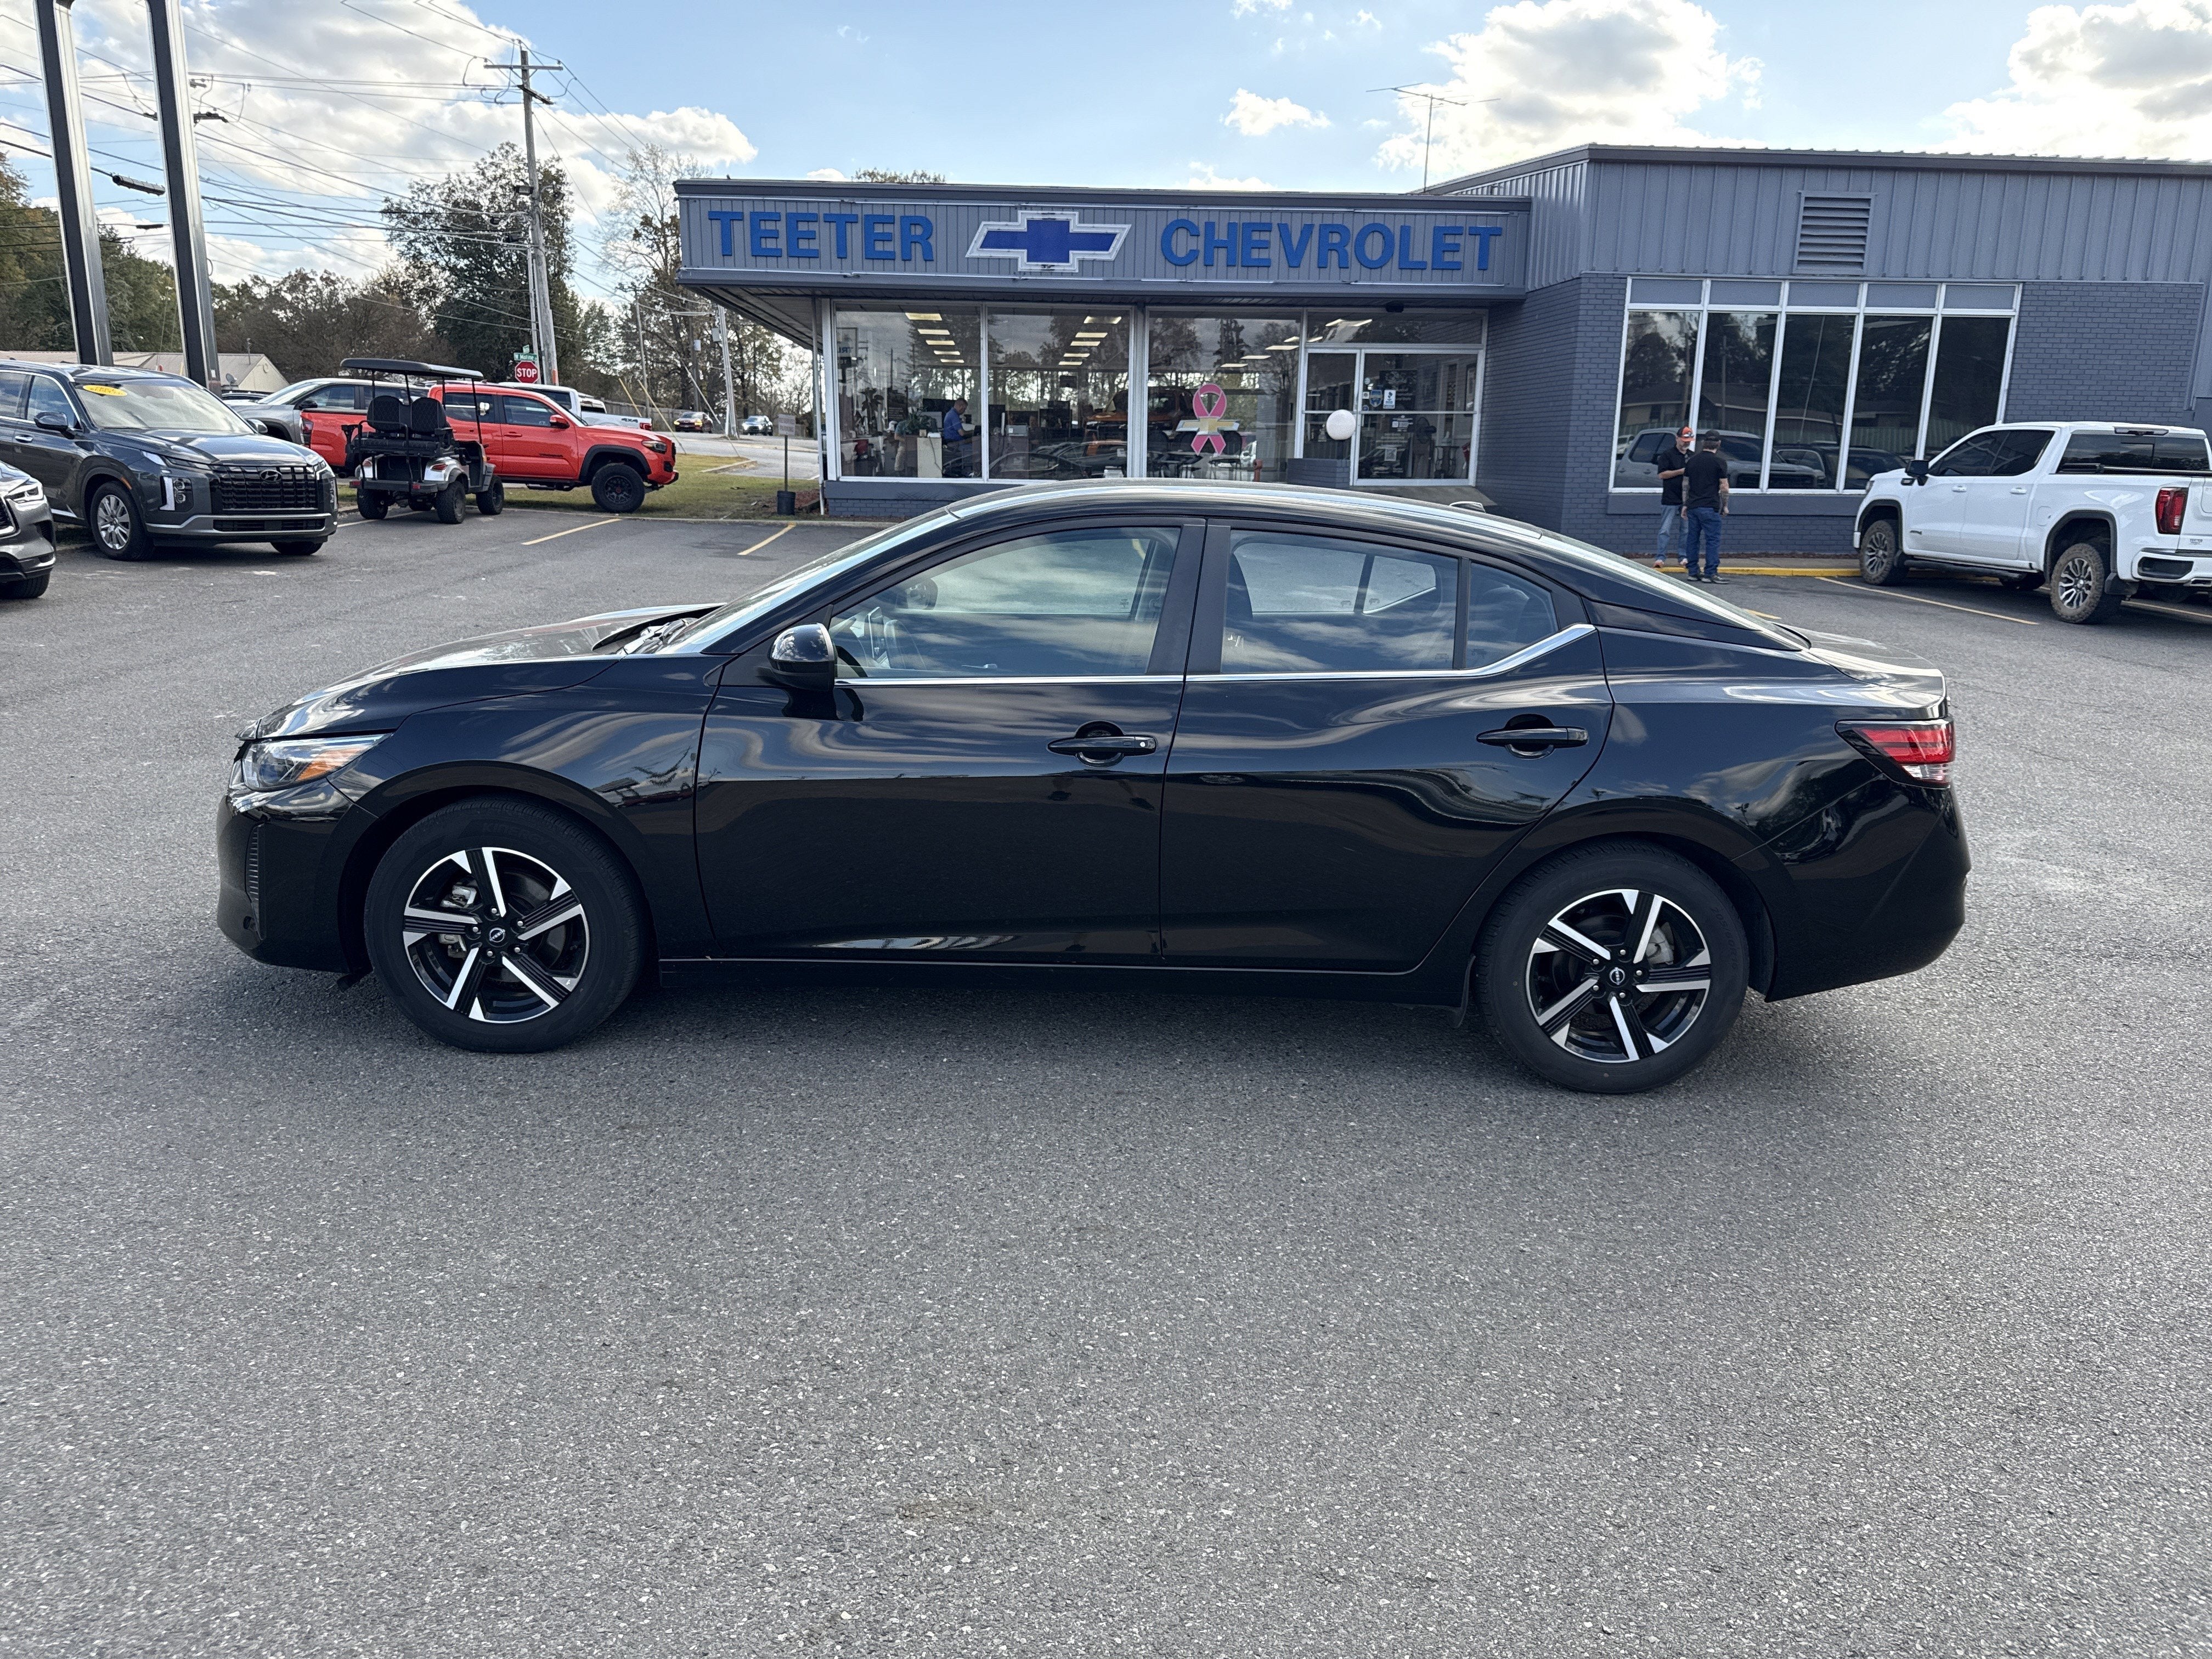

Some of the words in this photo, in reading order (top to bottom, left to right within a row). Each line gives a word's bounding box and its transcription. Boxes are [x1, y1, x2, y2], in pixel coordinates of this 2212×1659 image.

[708, 211, 934, 261] TEETER
[1161, 218, 1502, 270] CHEVROLET
[517, 368, 537, 377] STOP
